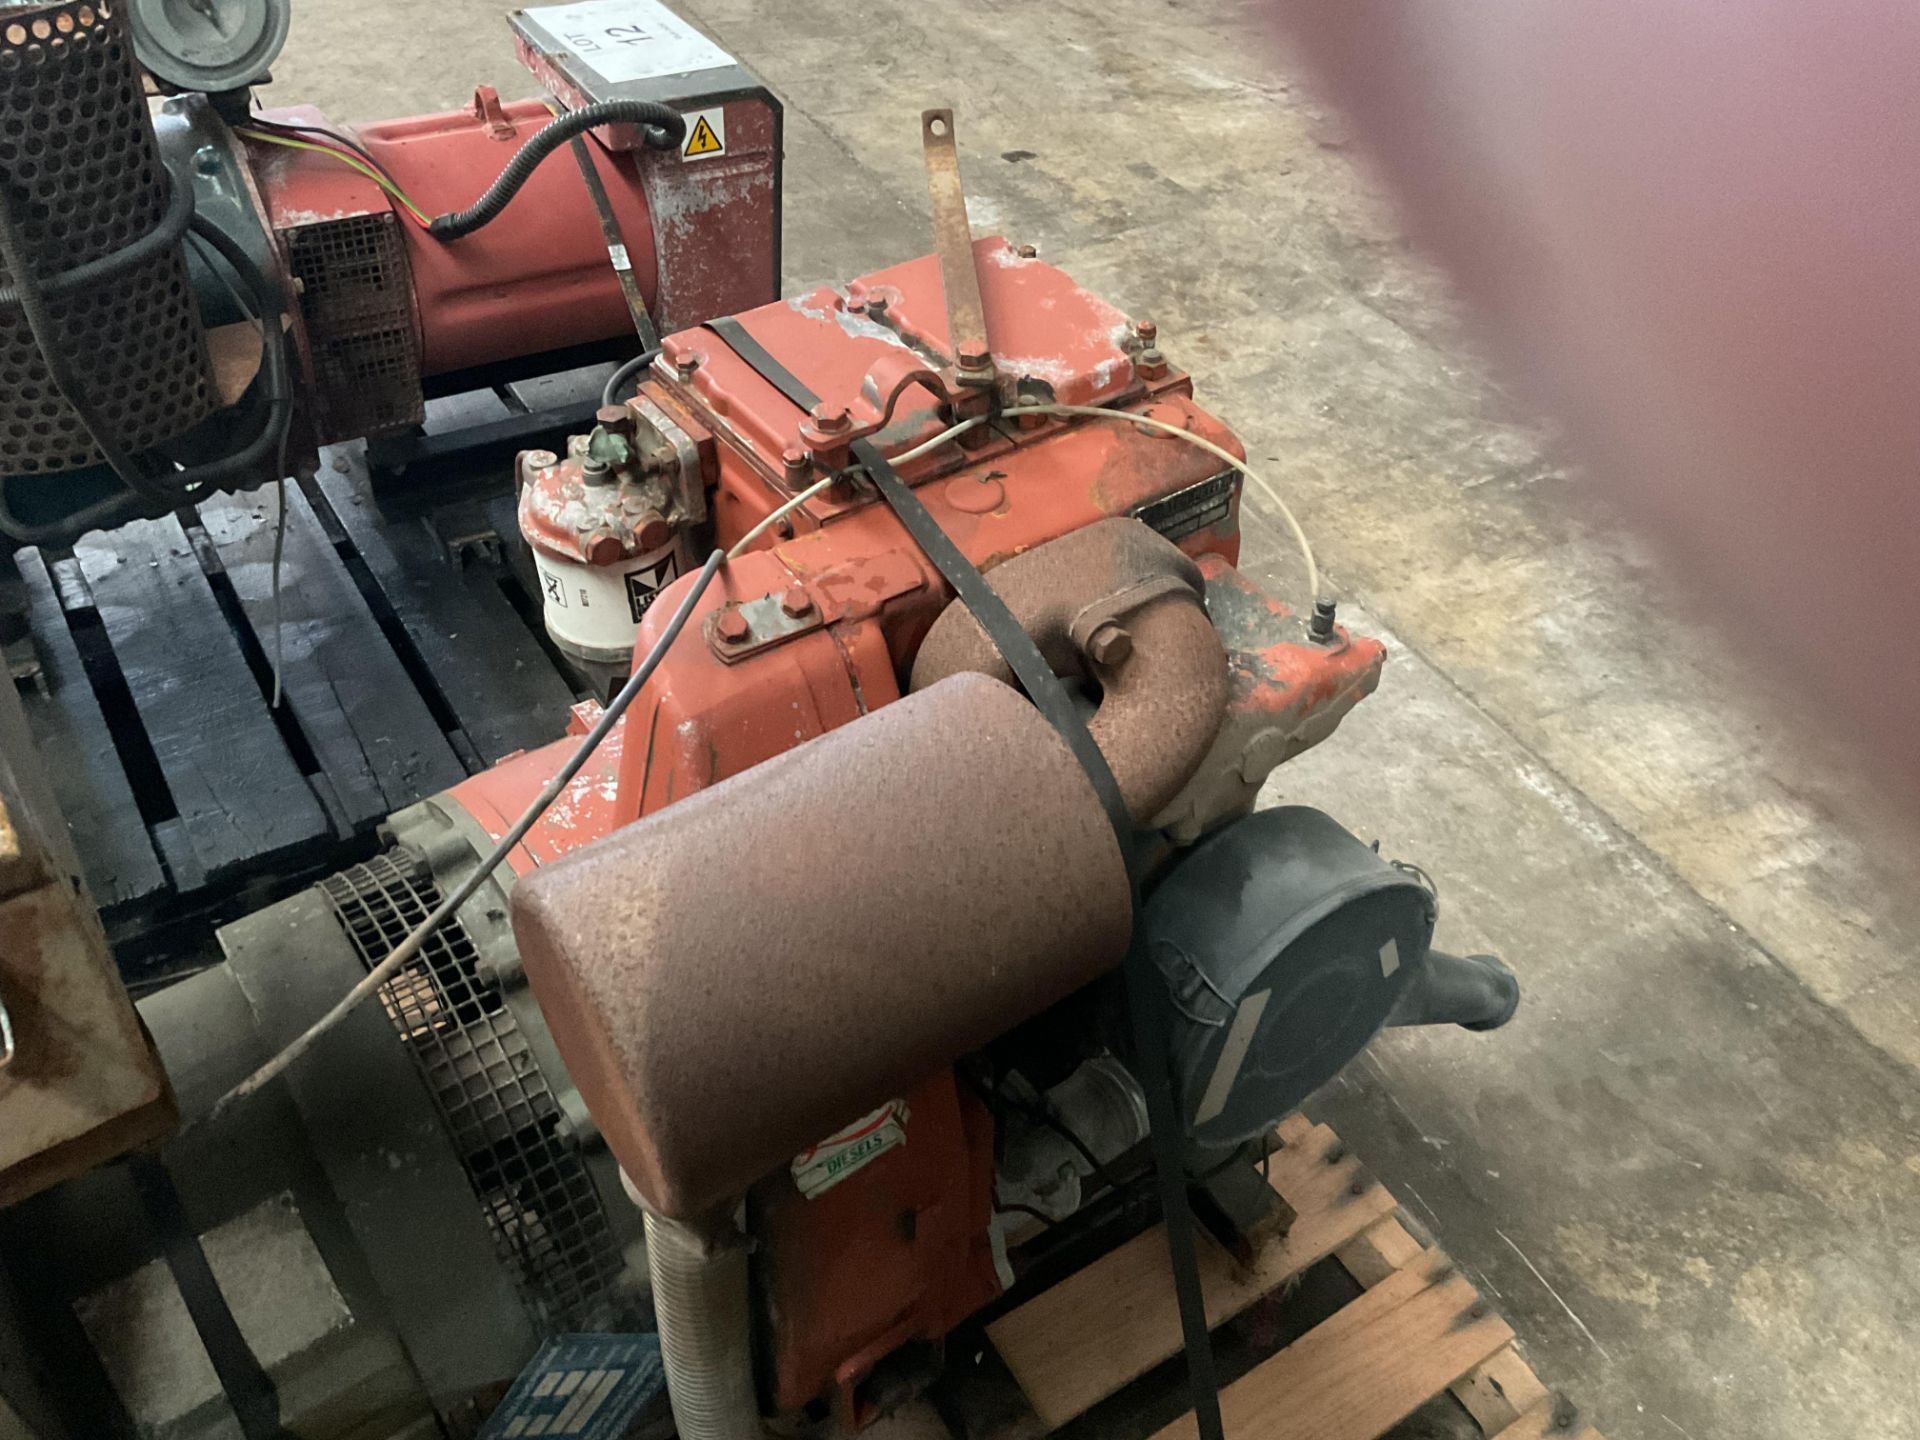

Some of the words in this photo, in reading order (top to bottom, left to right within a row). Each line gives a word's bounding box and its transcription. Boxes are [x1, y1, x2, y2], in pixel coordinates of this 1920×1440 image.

[564, 33, 602, 53] LOT
[605, 24, 653, 46] 12
[827, 1133, 883, 1175] DIESELS
